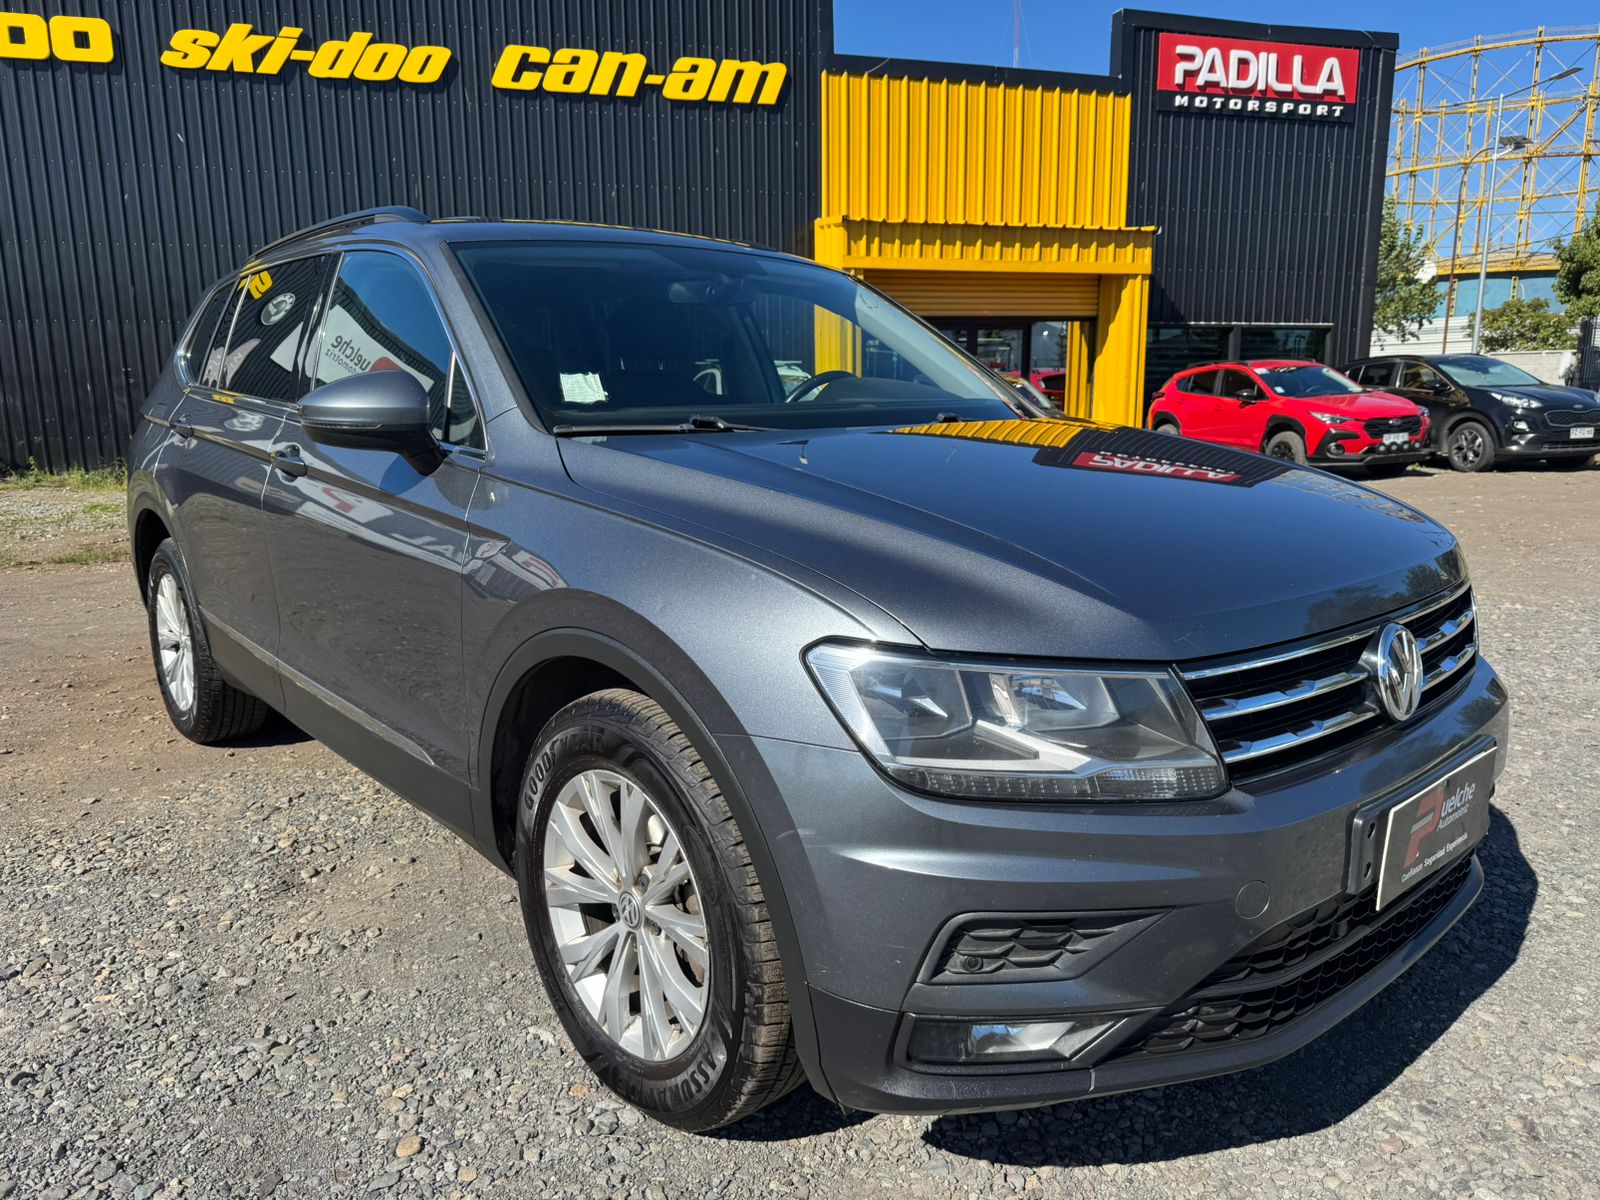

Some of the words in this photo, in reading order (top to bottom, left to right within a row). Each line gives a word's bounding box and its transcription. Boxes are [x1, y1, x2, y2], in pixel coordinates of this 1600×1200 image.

[160, 23, 452, 84] ski-doo
[491, 44, 788, 105] can-am
[1174, 45, 1346, 96] PADILLA
[1174, 94, 1344, 117] MOTORSPORT
